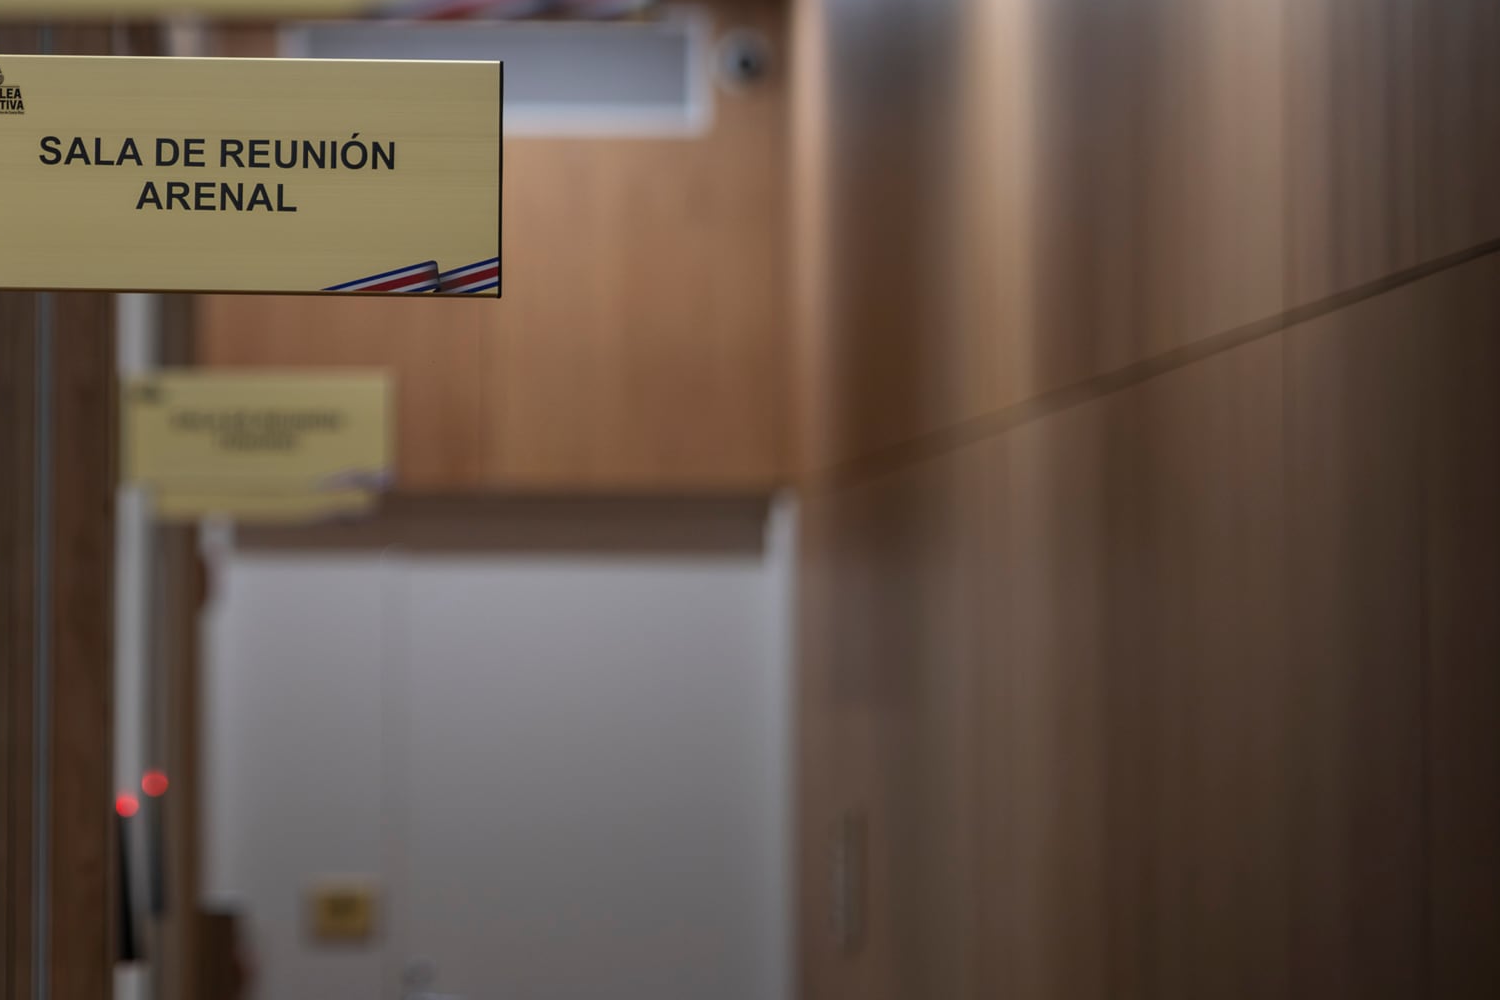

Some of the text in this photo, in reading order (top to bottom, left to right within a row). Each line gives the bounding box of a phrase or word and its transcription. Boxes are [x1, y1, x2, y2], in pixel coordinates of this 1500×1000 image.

[39, 133, 395, 170] SALA DE REUNIÓN
[136, 181, 297, 212] ARENAL
